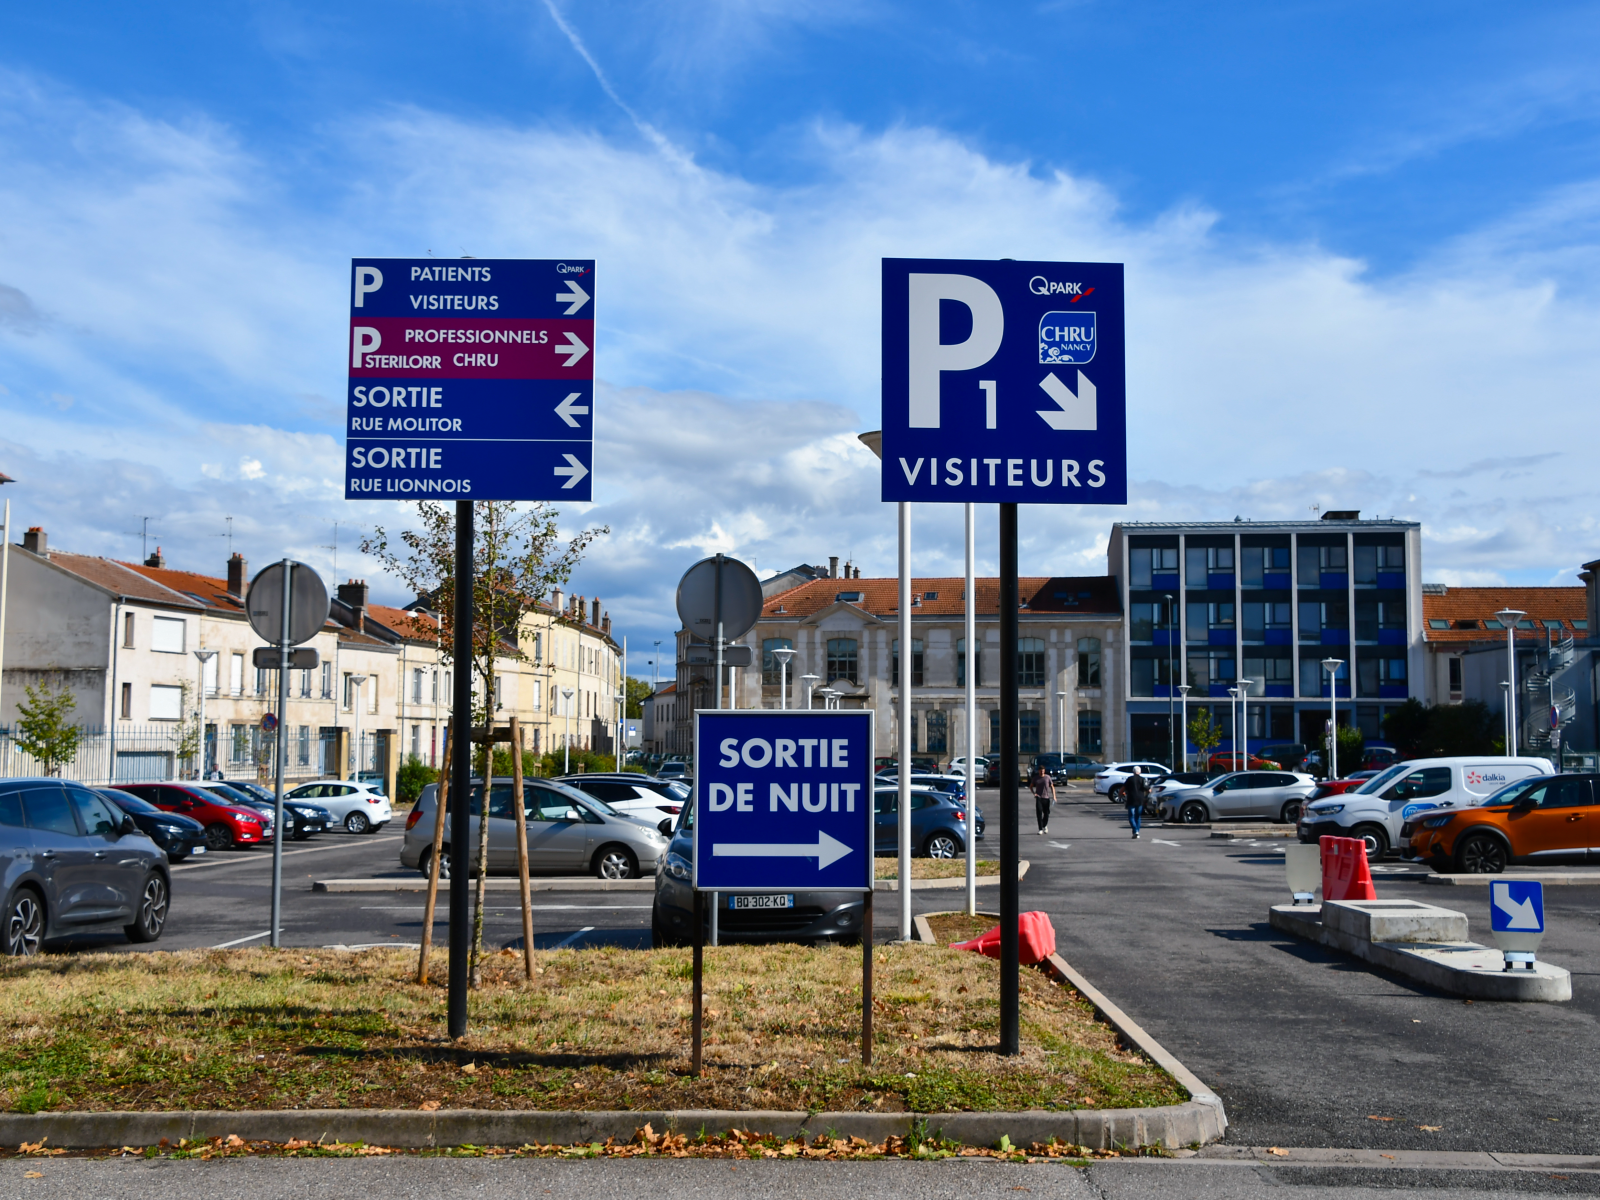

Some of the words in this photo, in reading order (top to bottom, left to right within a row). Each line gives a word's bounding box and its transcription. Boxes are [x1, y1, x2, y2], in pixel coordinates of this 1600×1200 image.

[354, 266, 384, 308] P
[411, 267, 492, 282] PATIENTS
[410, 295, 499, 310] VISITEURS
[405, 329, 549, 344] PROFESSIONNELS
[1041, 326, 1094, 342] CHRU
[352, 326, 382, 368] P
[909, 272, 1005, 429] P
[978, 379, 997, 430] 1
[1060, 343, 1092, 351] NANCY
[365, 355, 442, 369] STERILORR
[453, 353, 499, 367] CHRU
[352, 386, 443, 408] SORTIE
[352, 417, 383, 431] RUE
[387, 417, 463, 432] MOLITOR
[351, 447, 443, 469] SORTIE
[898, 457, 1106, 488] VISITEURS
[350, 478, 382, 492] RUE
[386, 479, 471, 493] LIONNOIS
[718, 737, 849, 769] SORTIE
[1482, 773, 1506, 782] dalkia
[708, 782, 754, 812] DE
[769, 782, 861, 813] NUIT
